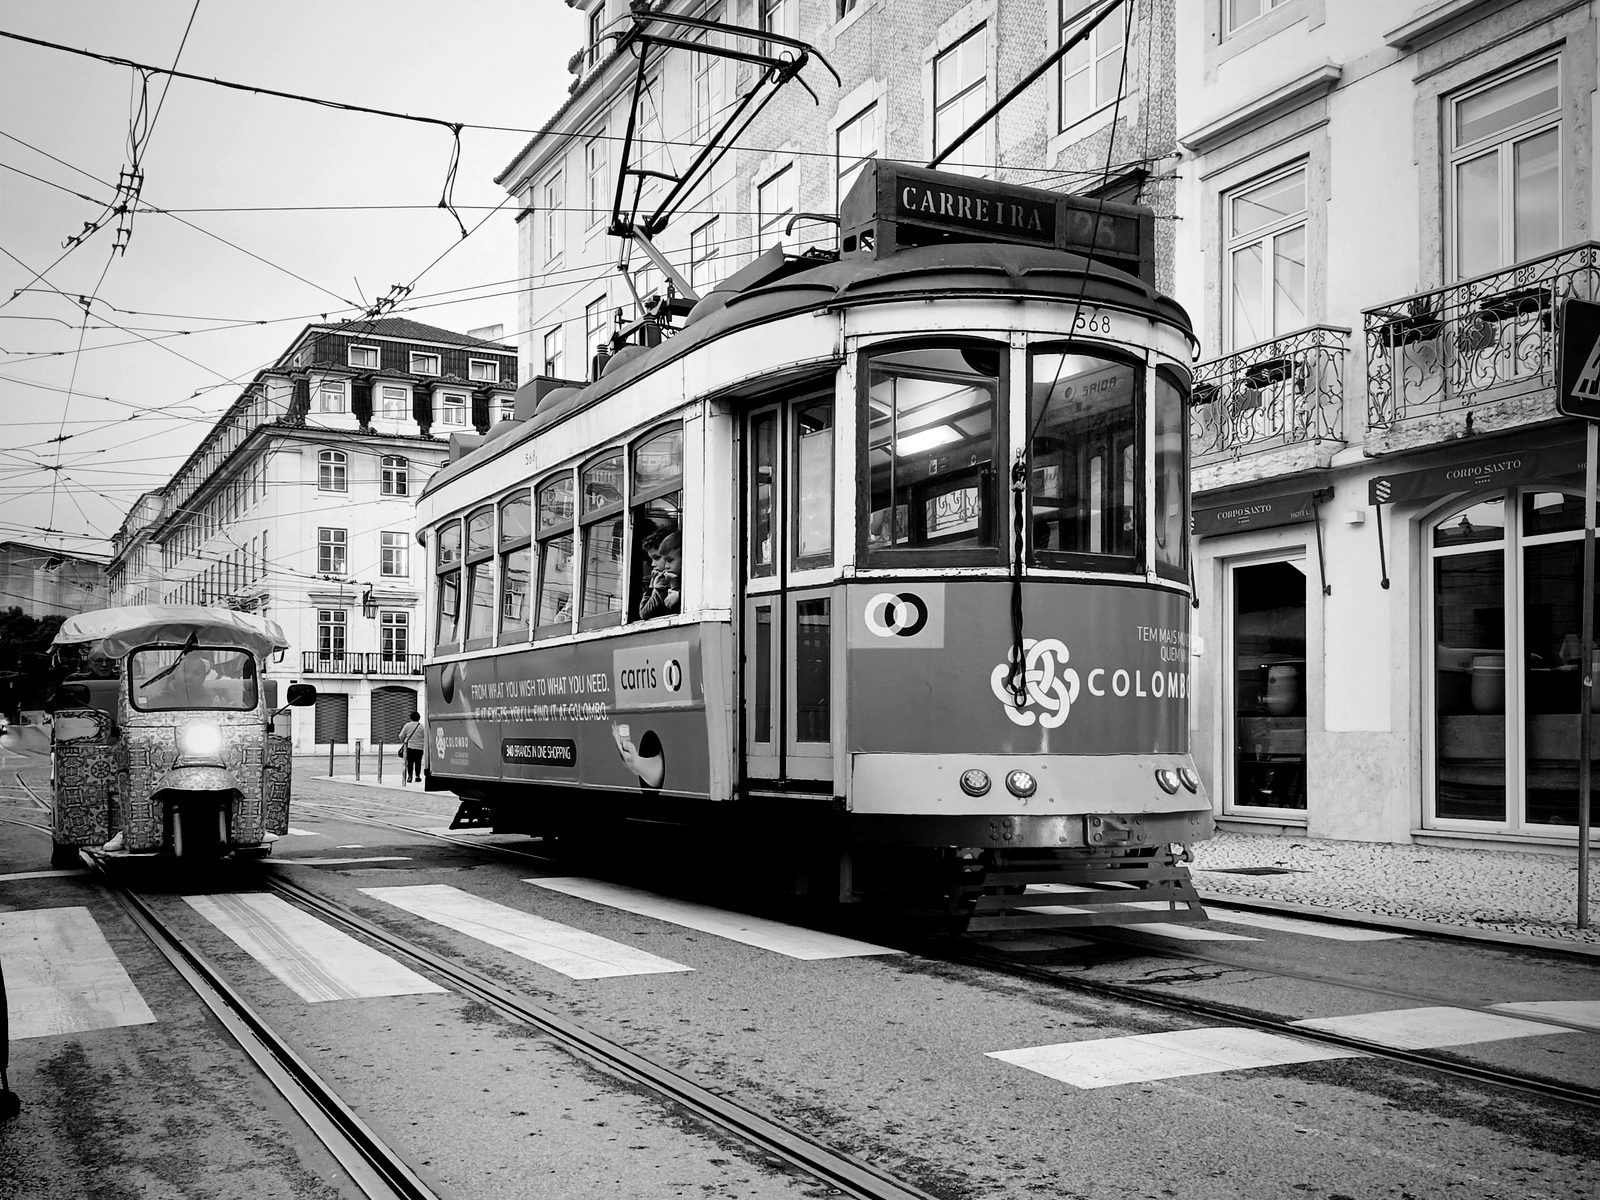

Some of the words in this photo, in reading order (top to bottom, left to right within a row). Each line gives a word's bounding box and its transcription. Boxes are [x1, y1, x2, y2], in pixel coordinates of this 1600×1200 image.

[902, 186, 1042, 231] CARREIRA
[1076, 311, 1111, 334] 568
[1446, 466, 1482, 480] CORPO
[1484, 459, 1521, 475] SANTO
[1217, 508, 1244, 520] CORPO
[1244, 504, 1272, 516] SANTO
[1290, 509, 1310, 519] HOTEL
[1136, 626, 1158, 642] TEM
[1159, 628, 1177, 645] MAIS
[620, 659, 657, 690] carris
[471, 684, 487, 700] FROM
[488, 682, 504, 699] WHAT
[505, 681, 518, 698] YOU
[519, 679, 536, 697] WISH
[536, 678, 546, 696] TO
[547, 676, 567, 695] WHAT
[568, 675, 585, 694] YOU
[586, 673, 610, 693] NEED.
[568, 702, 609, 721] COLOMBO.
[547, 746, 571, 759] SHOPPING
